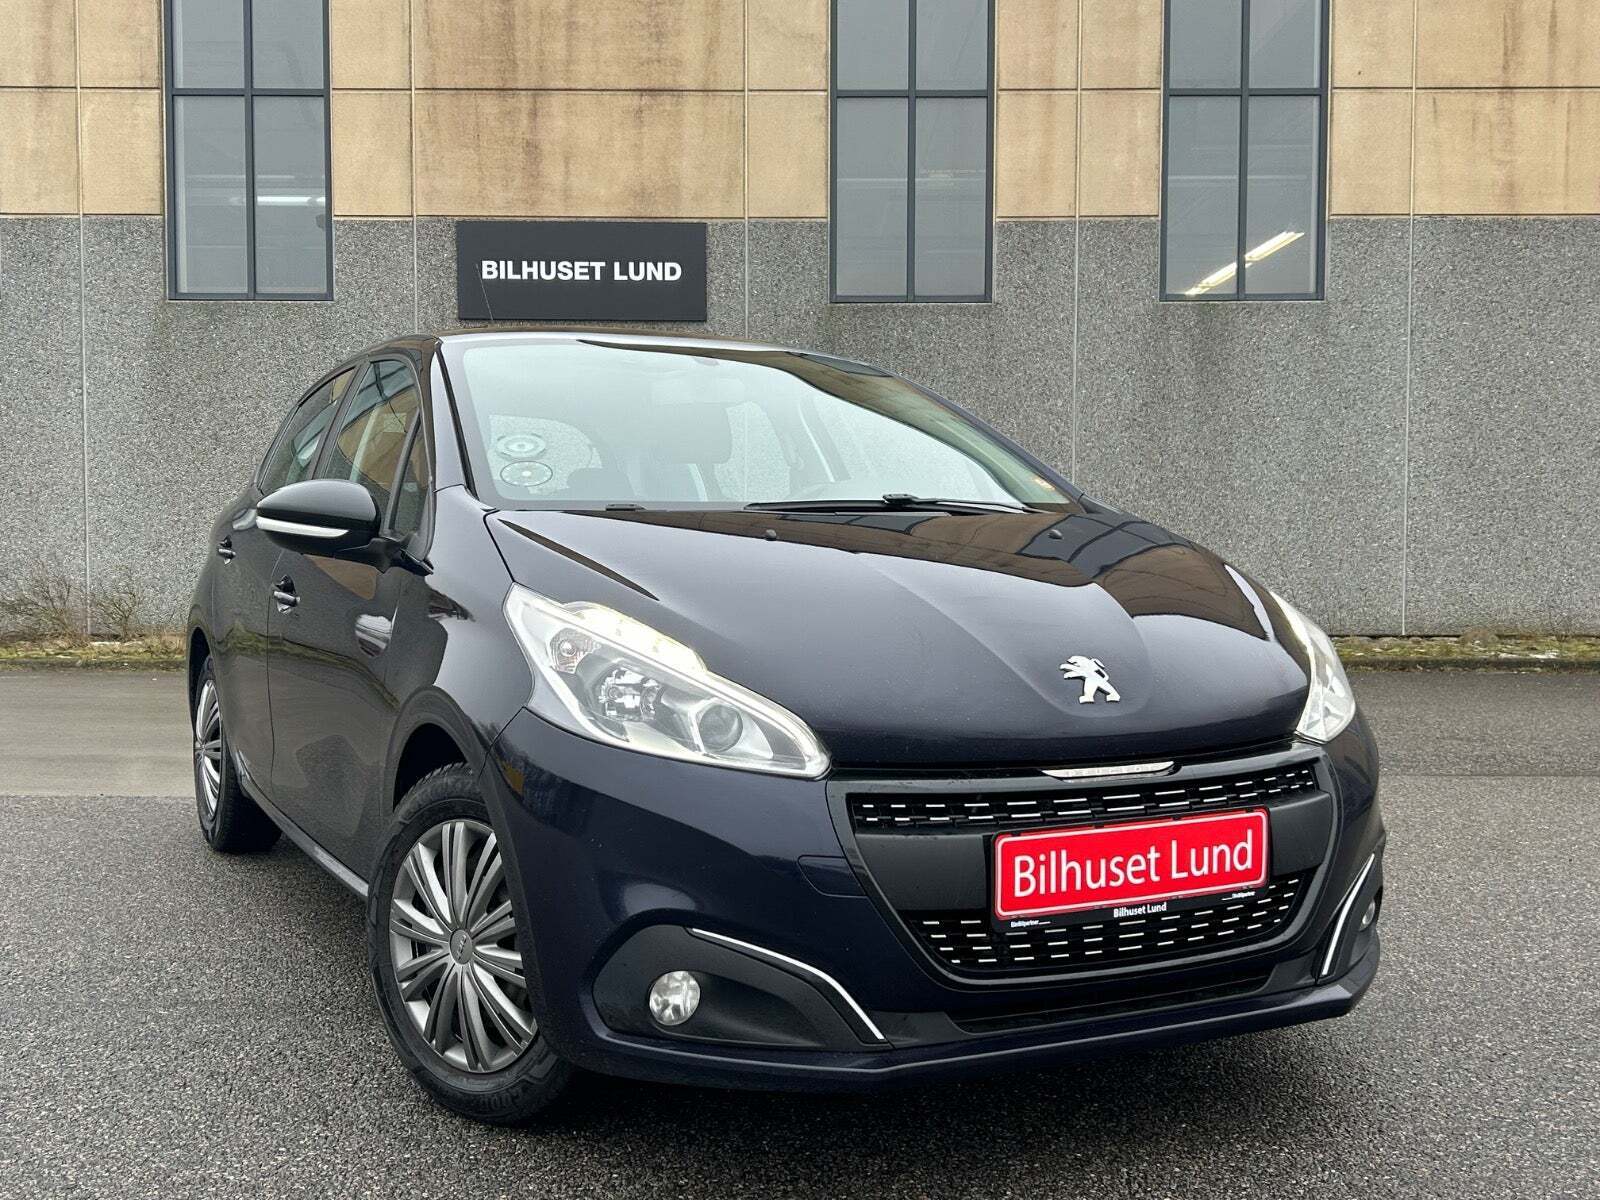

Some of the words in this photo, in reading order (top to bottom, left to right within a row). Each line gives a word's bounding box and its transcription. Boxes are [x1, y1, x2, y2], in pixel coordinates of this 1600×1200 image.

[481, 260, 606, 281] BILHUSET
[613, 261, 683, 281] LUND
[1013, 845, 1161, 898] Bilhuset
[1170, 828, 1254, 880] Lund
[1113, 905, 1146, 918] Bilhuset
[1147, 901, 1167, 913] Lund
